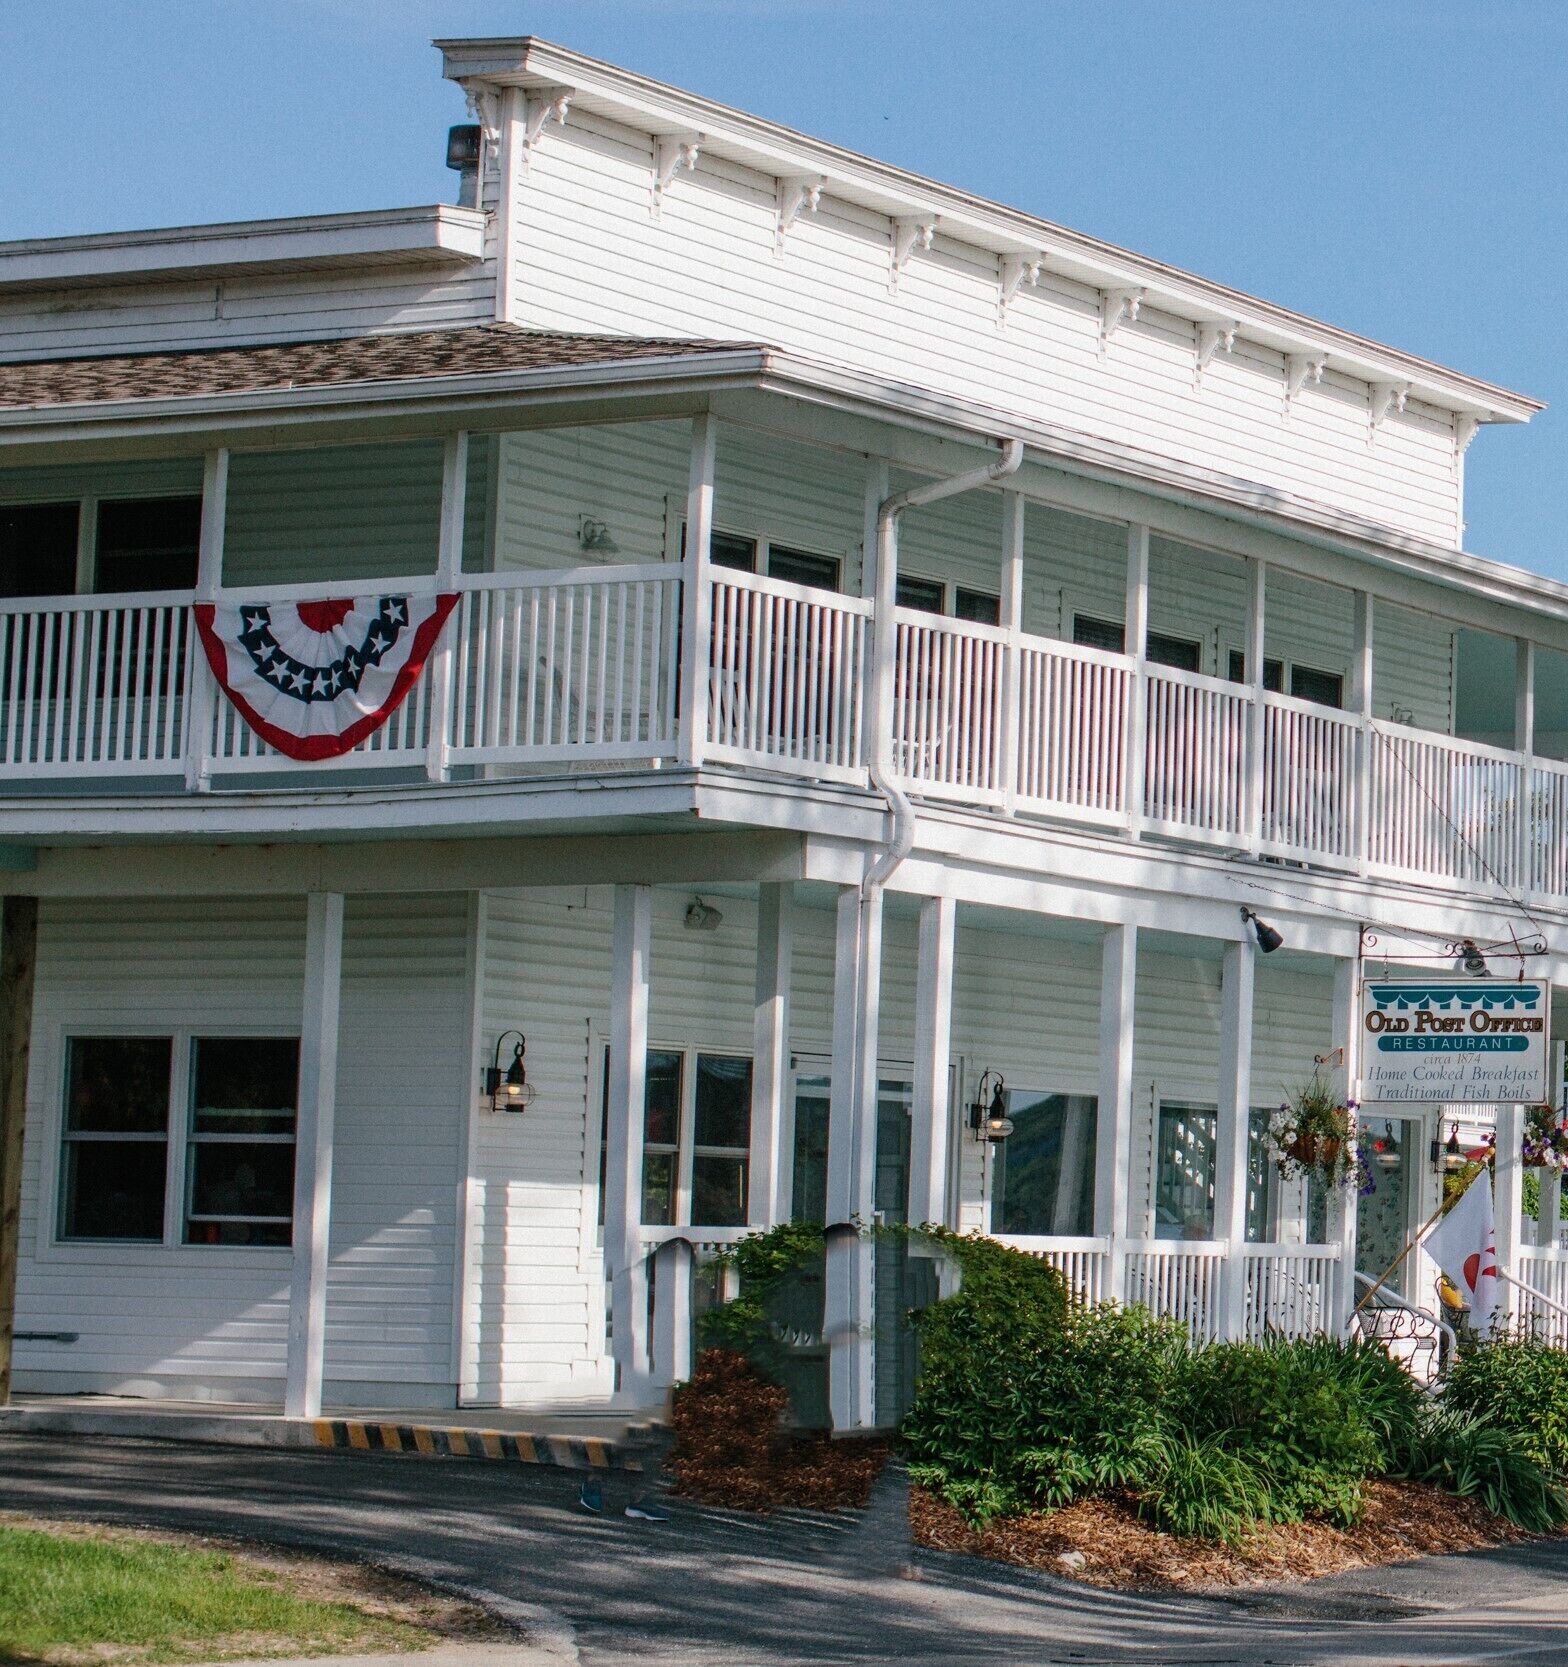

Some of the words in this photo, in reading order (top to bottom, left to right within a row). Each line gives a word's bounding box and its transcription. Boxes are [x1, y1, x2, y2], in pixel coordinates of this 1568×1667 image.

[1365, 1010, 1410, 1033] OLD
[1414, 1011, 1465, 1032] POST
[1470, 1010, 1543, 1033] OFFICE
[1393, 1037, 1513, 1049] RESTAURANT
[1424, 1053, 1451, 1064] circa
[1457, 1053, 1482, 1064] 1874
[1368, 1066, 1407, 1080] Home
[1413, 1065, 1464, 1080] Cooked
[1472, 1064, 1539, 1084] Breakfast
[1376, 1084, 1455, 1099] Traditional
[1463, 1084, 1490, 1099] Fish
[1497, 1084, 1531, 1099] Boils
